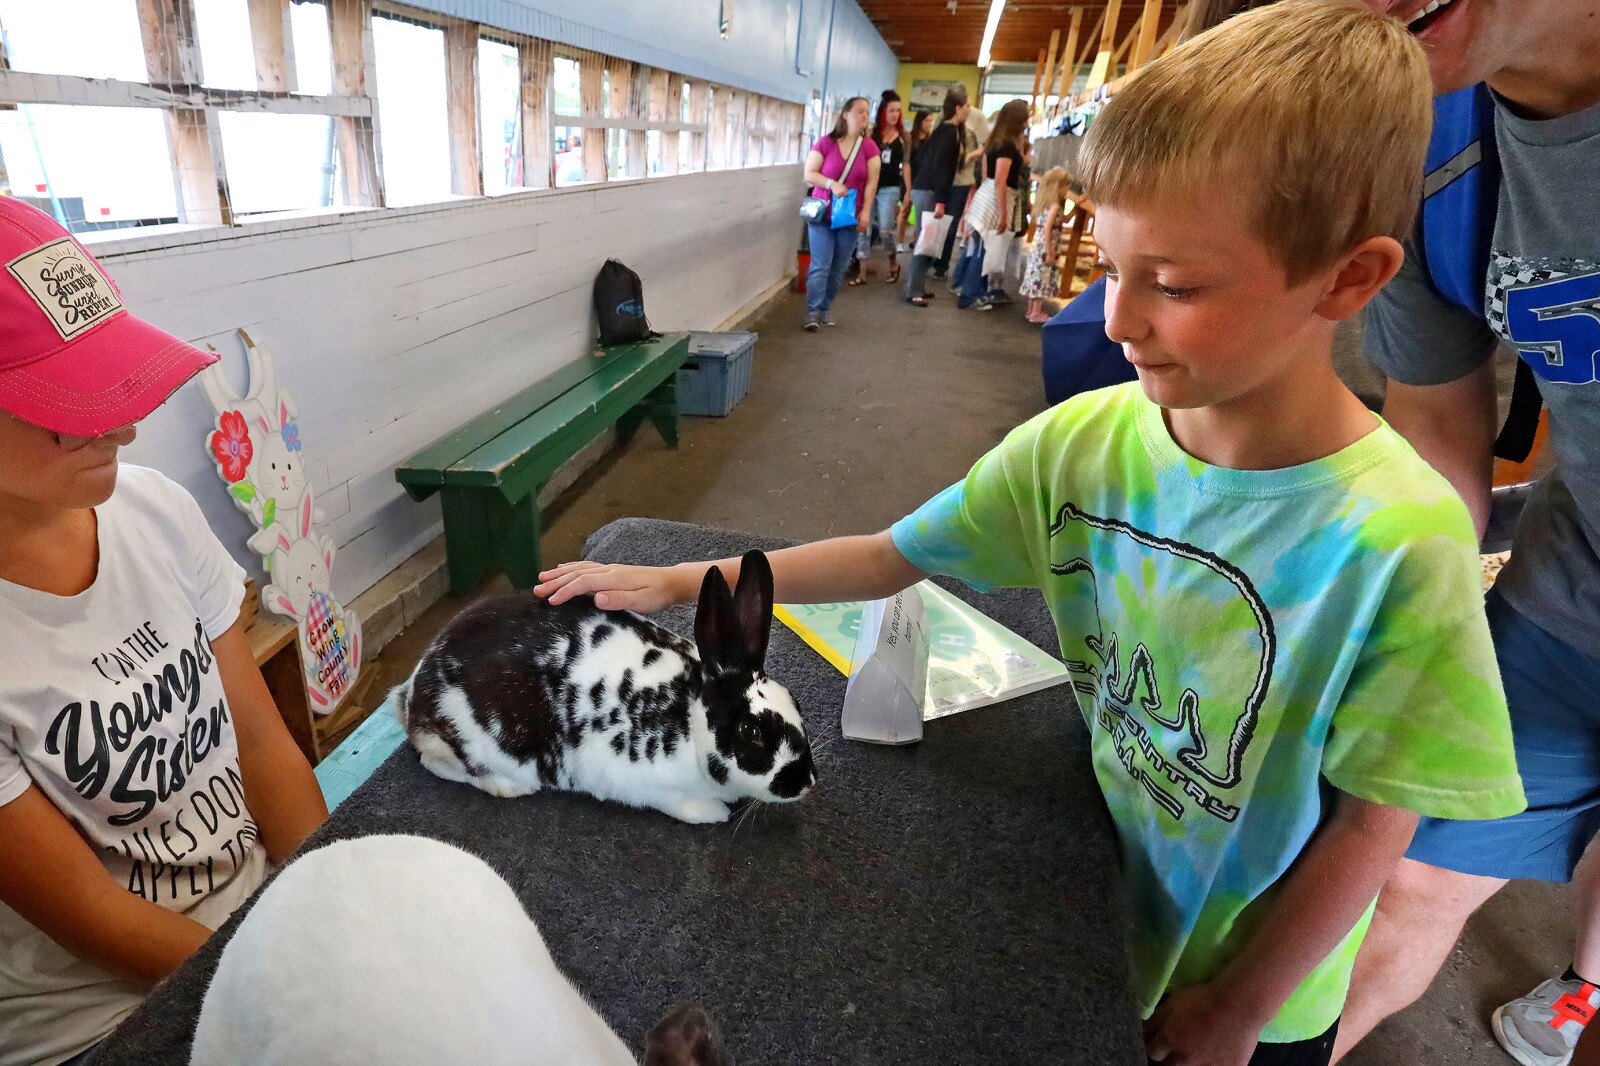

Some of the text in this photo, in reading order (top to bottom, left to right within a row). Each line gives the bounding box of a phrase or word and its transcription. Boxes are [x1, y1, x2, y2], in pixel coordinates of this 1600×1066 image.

[40, 265, 86, 297] Sunrise
[57, 273, 97, 297] SUNBURN
[58, 285, 101, 325] Sunset
[78, 297, 113, 321] REPEAT
[1506, 271, 1600, 385] 5
[123, 620, 168, 664] THE
[309, 615, 335, 646] Crow
[316, 630, 340, 661] Wing
[317, 641, 349, 684] County
[328, 670, 347, 695] Fair
[107, 698, 228, 827] Sister
[128, 855, 213, 903] APPLY
